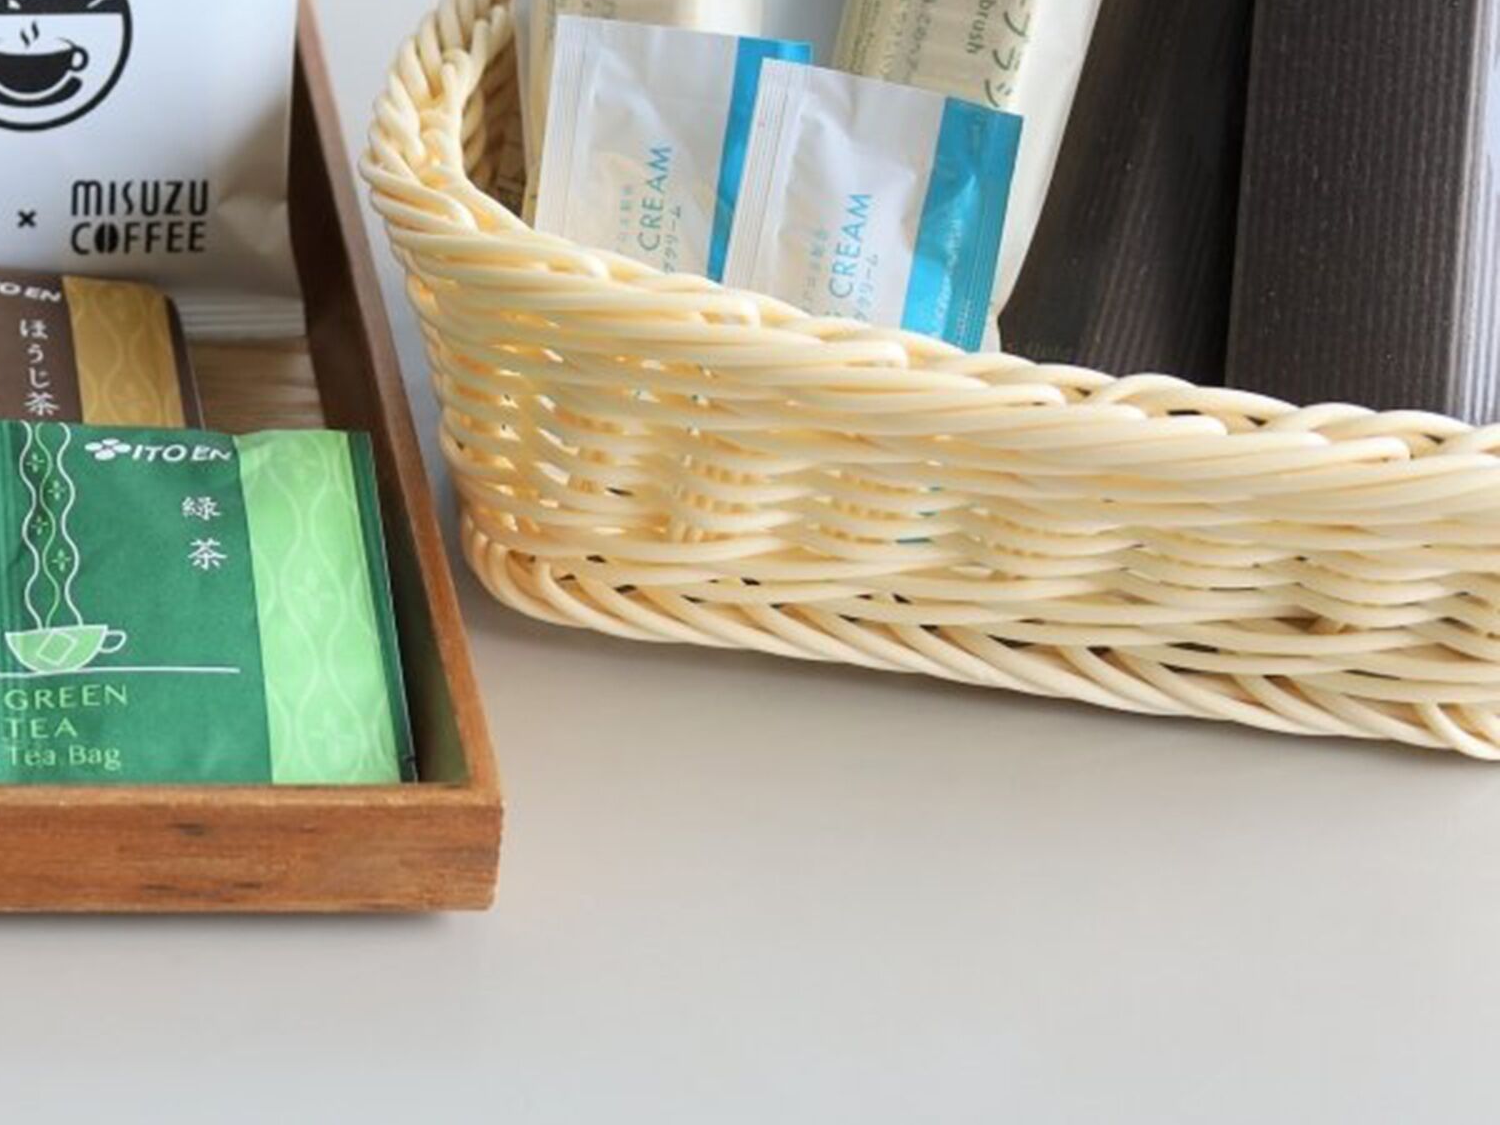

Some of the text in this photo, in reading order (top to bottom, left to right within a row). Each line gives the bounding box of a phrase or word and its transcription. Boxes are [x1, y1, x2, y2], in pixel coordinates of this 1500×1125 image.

[71, 178, 210, 218] MISUZU
[638, 144, 674, 252] CREAM
[71, 221, 208, 256] COFFEE
[829, 192, 873, 299] CREAM
[24, 285, 62, 303] EN
[19, 318, 60, 416] ほうじ茶
[132, 443, 233, 463] ITO EN
[181, 495, 229, 571] 緑茶
[3, 683, 129, 712] GREEN
[5, 716, 79, 740] TEA
[8, 743, 122, 772] Tea Bag
